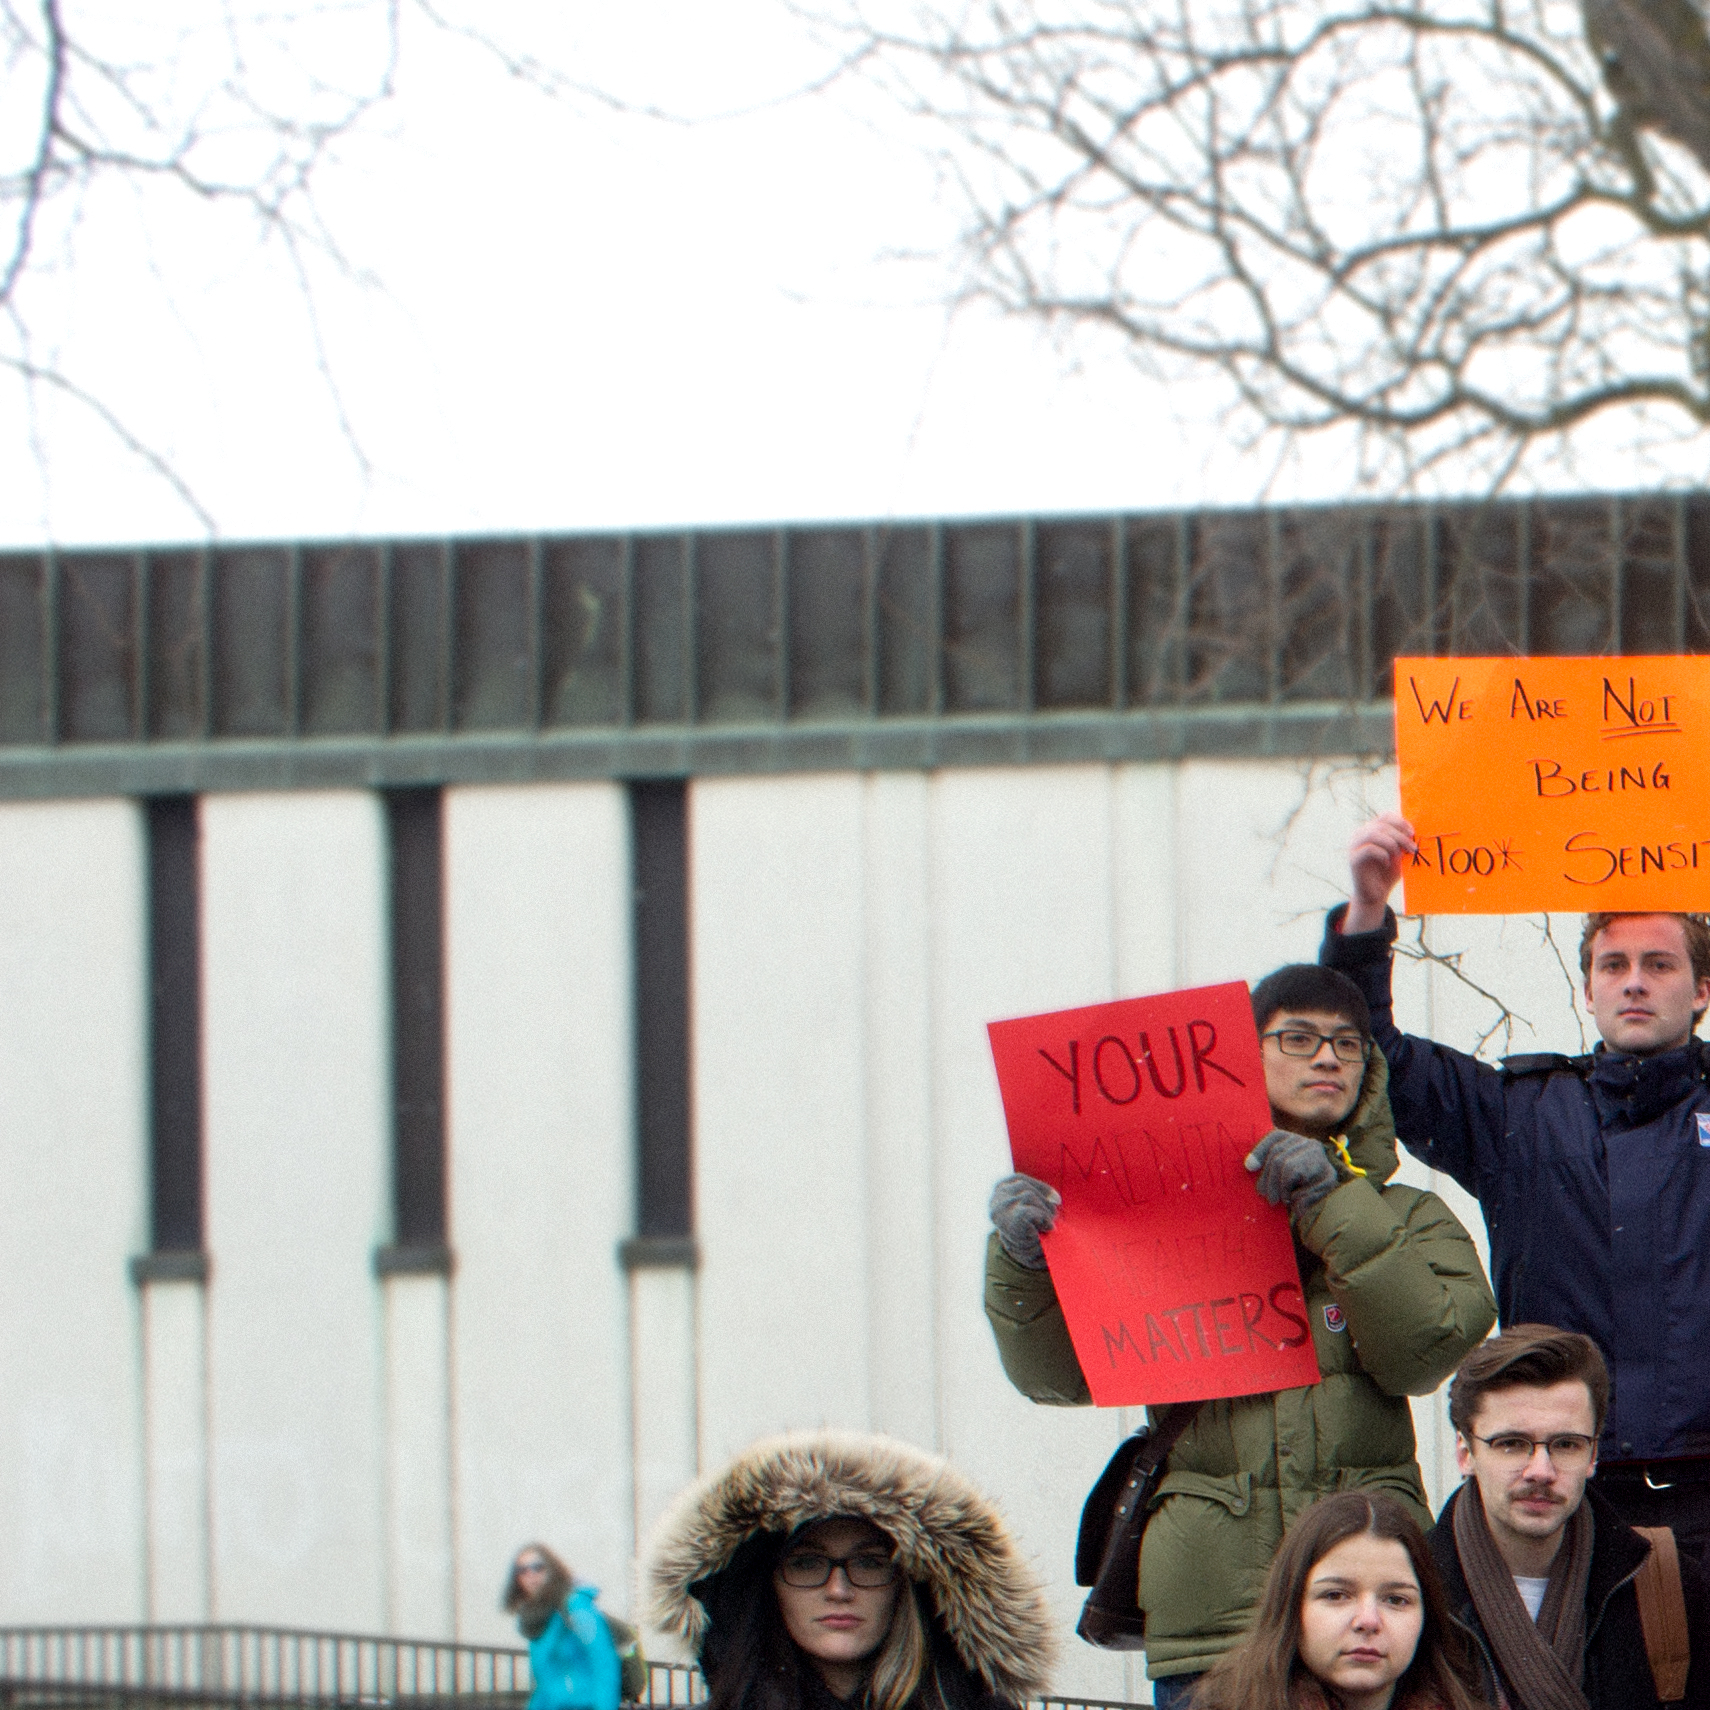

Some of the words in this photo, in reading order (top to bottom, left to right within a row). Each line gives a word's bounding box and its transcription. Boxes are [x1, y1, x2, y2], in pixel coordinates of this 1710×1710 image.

[1602, 677, 1679, 729] NOT
[1527, 759, 1671, 798] BEING
[1037, 1019, 1246, 1116] YOUR
[1099, 1282, 1309, 1368] MATTERS
